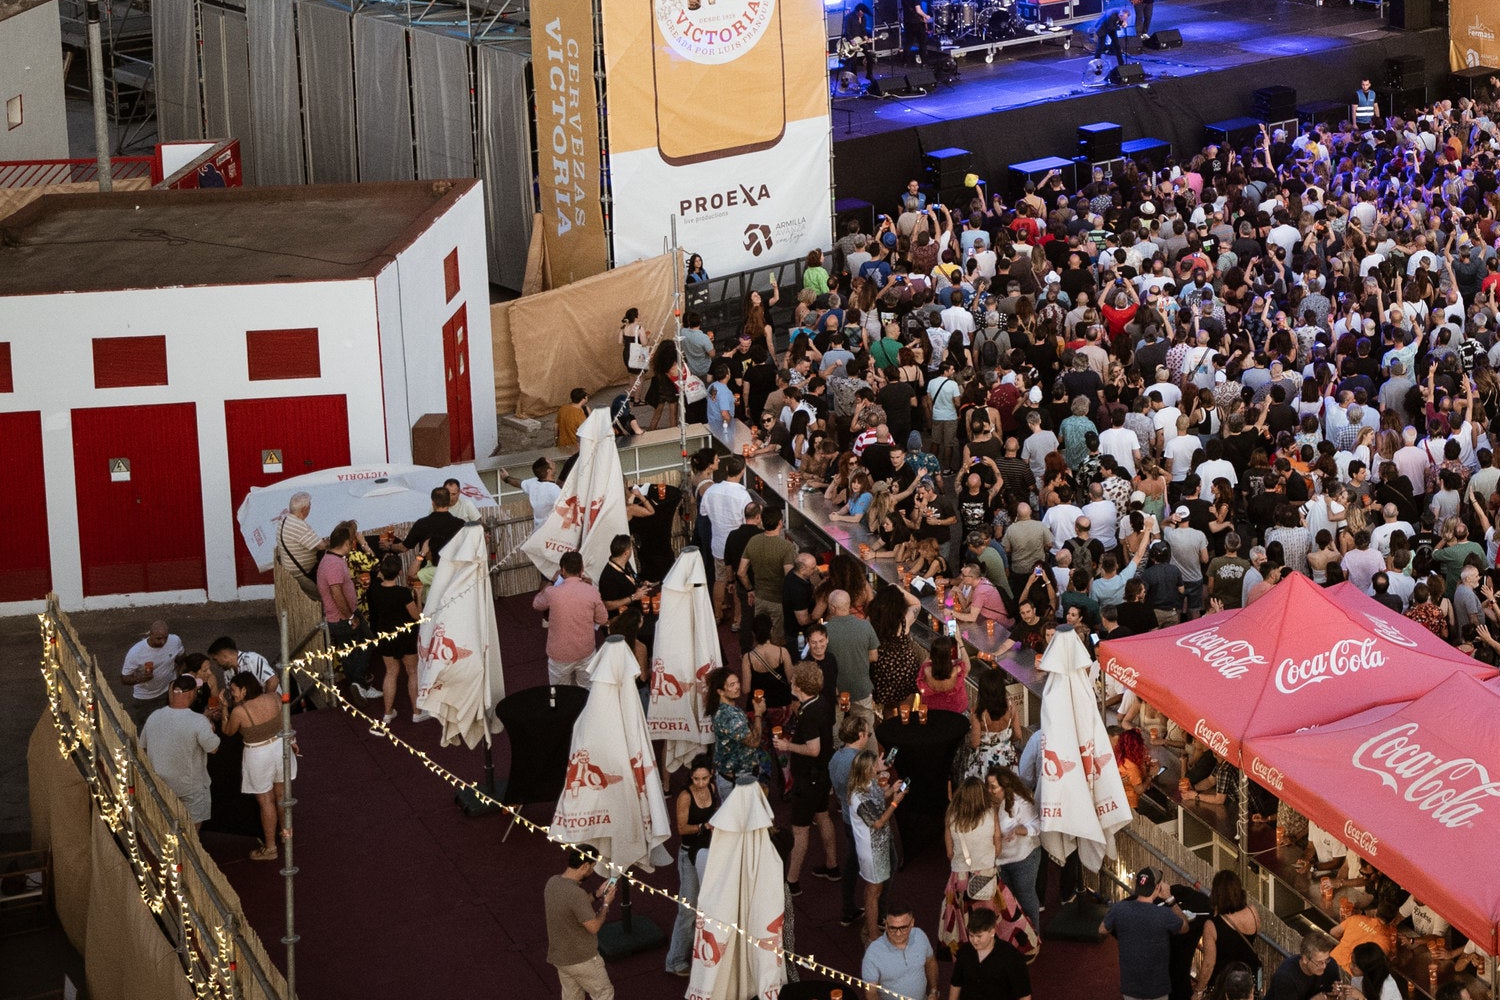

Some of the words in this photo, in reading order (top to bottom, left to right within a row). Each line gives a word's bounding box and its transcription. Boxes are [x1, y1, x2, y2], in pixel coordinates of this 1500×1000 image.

[666, 17, 693, 52] CREADA
[694, 46, 716, 56] POR
[718, 41, 742, 55] LUIS
[676, 0, 761, 45] VICTORIA
[1467, 28, 1495, 39] Fermasa
[545, 17, 572, 237] VICTORIA
[567, 38, 586, 227] CERVEZAS
[680, 183, 771, 216] PROEXA
[683, 216, 695, 224] live
[695, 210, 729, 223] productions
[775, 216, 807, 230] ARMILLA
[337, 471, 389, 481] VICTORIA
[1176, 626, 1269, 679] Coca-Cola
[1275, 637, 1387, 694] Coca-Cola
[1106, 657, 1141, 688] Coca-Cola
[1194, 718, 1230, 758] Coca-Cola
[1251, 756, 1285, 791] Coca-Cola
[1344, 820, 1379, 857] Coca-Cola
